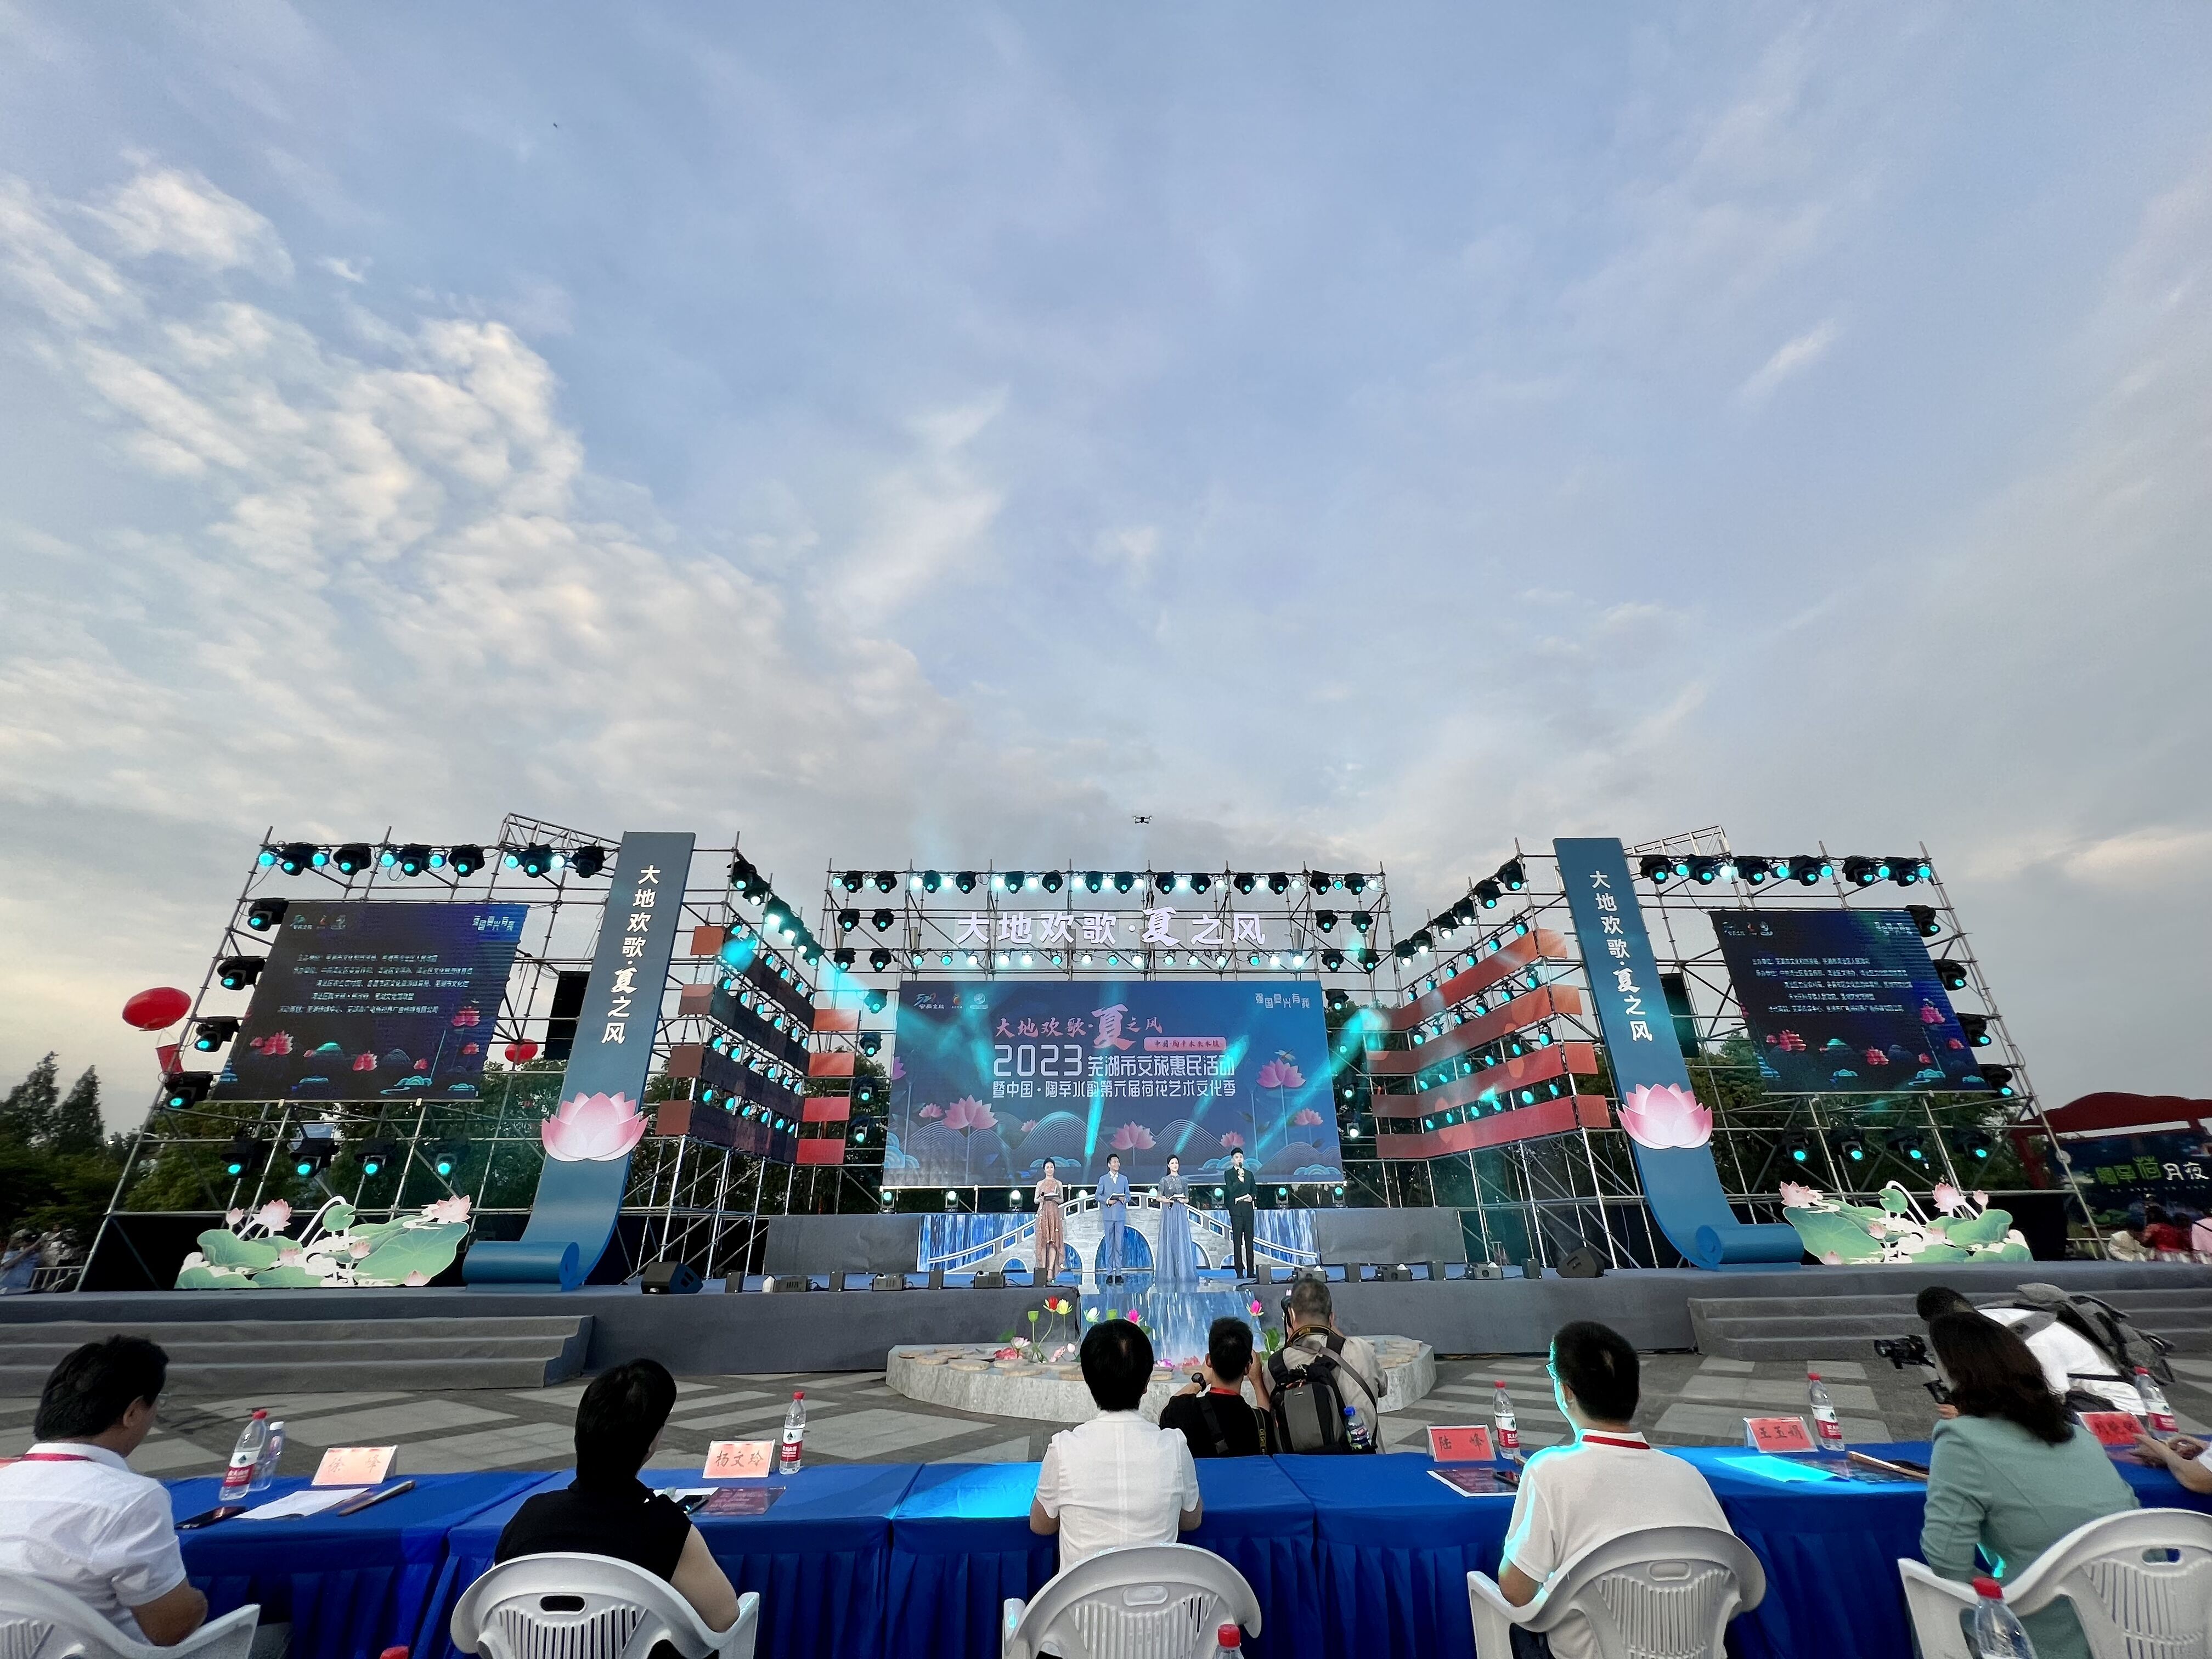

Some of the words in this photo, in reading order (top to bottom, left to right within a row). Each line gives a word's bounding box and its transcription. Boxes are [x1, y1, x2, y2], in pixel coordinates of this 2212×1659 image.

[956, 906, 1266, 947] 大地欢歌·夏之风
[994, 1044, 1083, 1076] 2023
[1087, 1055, 1235, 1076] 芜湖市文旅惠民活动
[714, 1450, 764, 1467] 杨文玲
